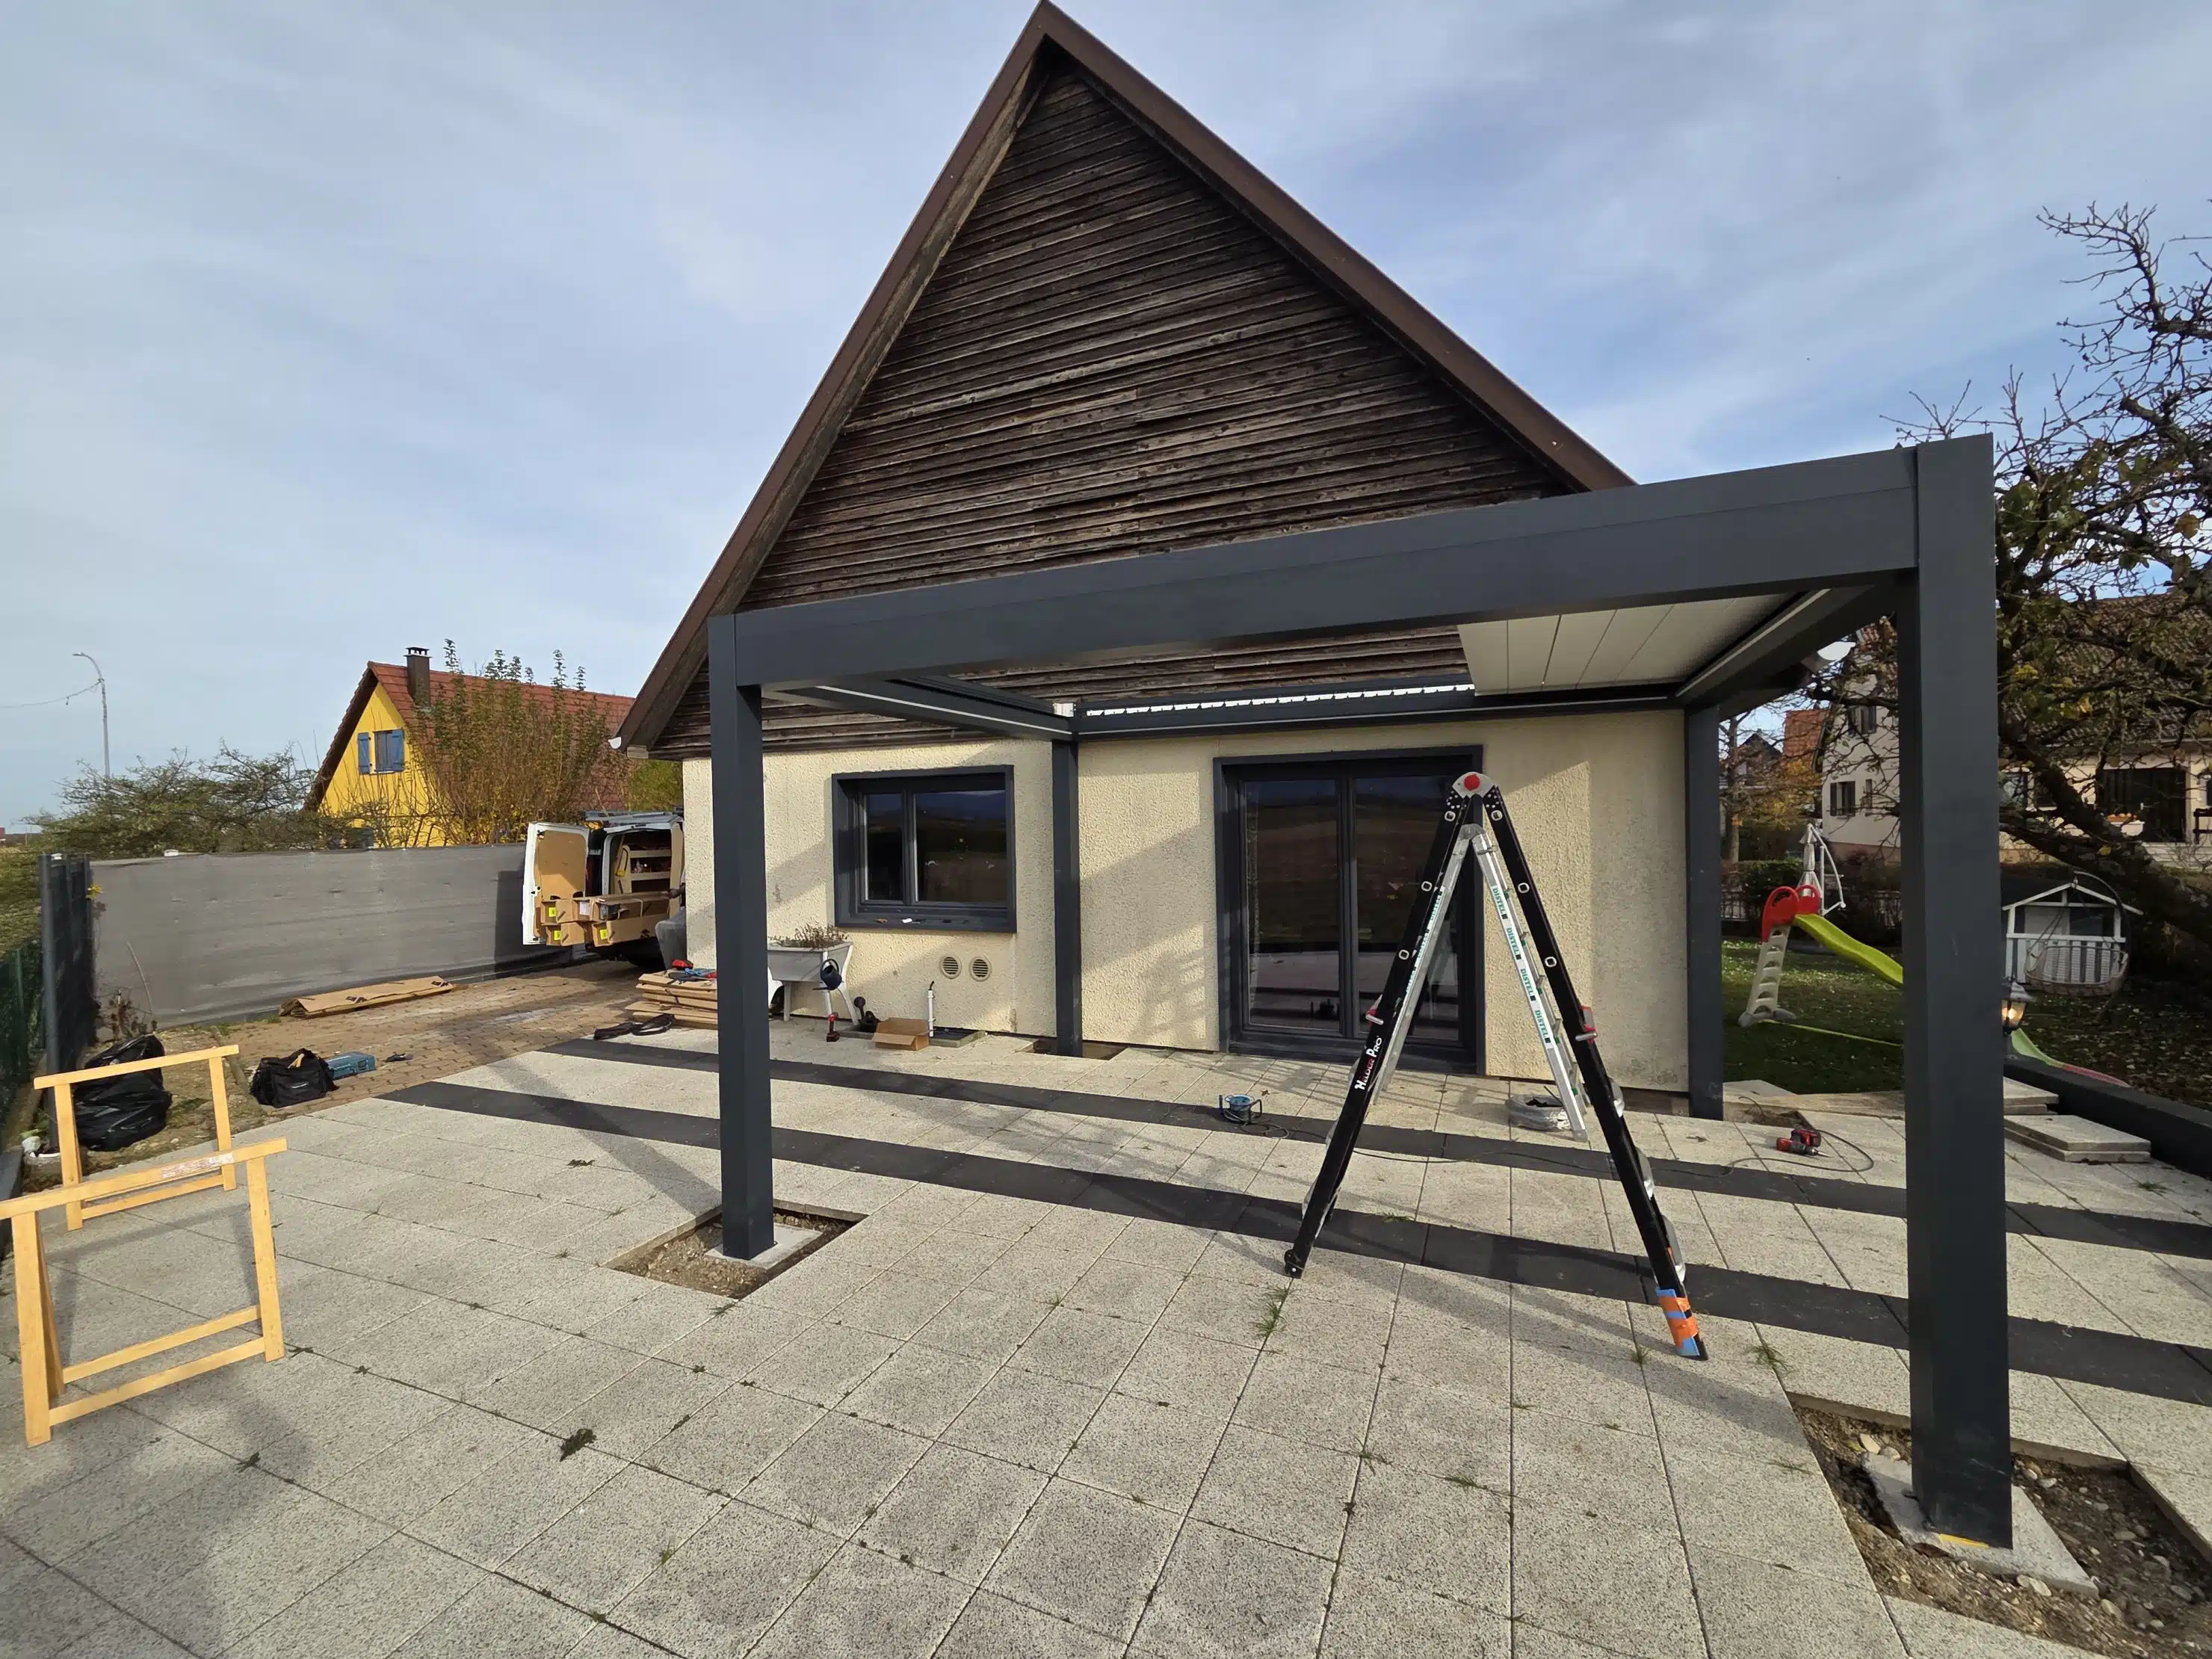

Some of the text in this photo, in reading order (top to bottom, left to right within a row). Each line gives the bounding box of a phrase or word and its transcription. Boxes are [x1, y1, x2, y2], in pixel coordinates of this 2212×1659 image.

[1492, 888, 1549, 1037] DISTEL DISTEL DISTEL DISTEL
[1366, 1037, 1382, 1057] PRO
